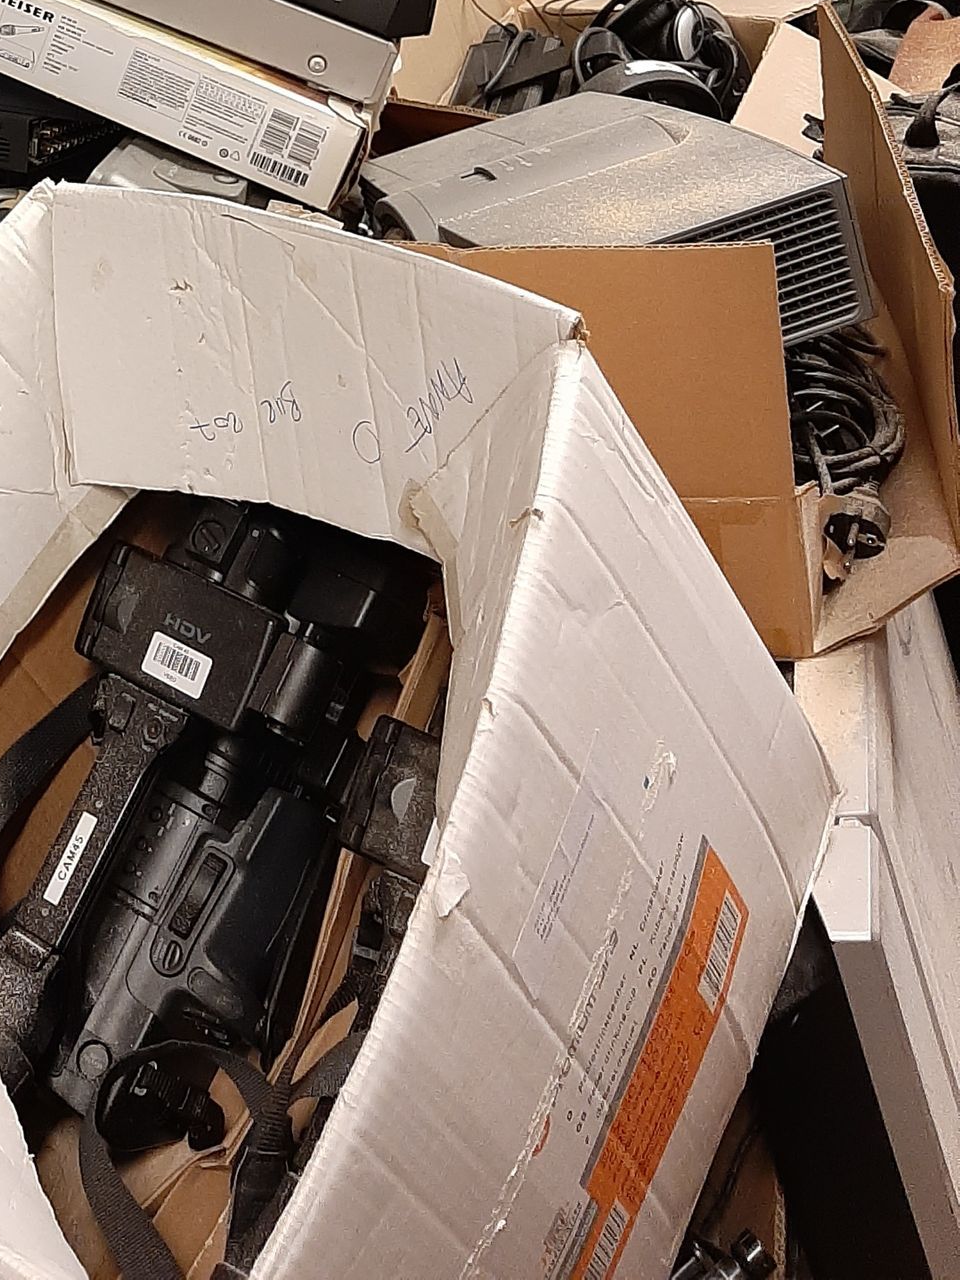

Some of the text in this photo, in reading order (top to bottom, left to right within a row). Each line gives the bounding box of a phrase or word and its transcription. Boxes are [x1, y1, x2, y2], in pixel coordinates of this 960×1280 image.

[190, 411, 244, 441] 207
[163, 612, 212, 644] HDV
[57, 834, 84, 881] CAM45
